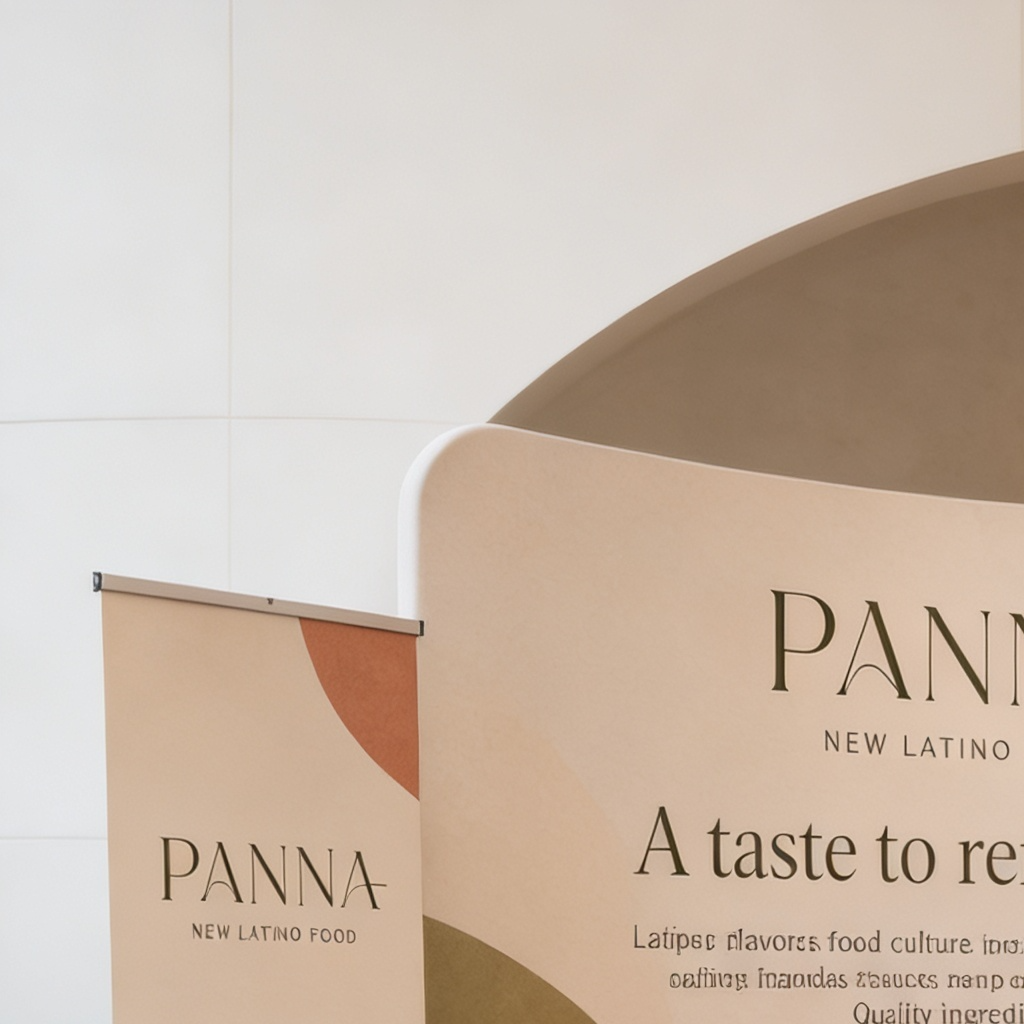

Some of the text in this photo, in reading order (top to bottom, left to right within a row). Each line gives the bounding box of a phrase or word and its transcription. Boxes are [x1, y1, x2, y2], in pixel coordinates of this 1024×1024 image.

[824, 729, 887, 756] NEW
[903, 734, 1010, 761] LATINO
[633, 805, 691, 877] A
[706, 817, 857, 882] taste
[875, 825, 936, 885] to
[160, 836, 388, 911] PANNA
[191, 922, 357, 944] NEW LATINO FOOD
[827, 929, 882, 953] food
